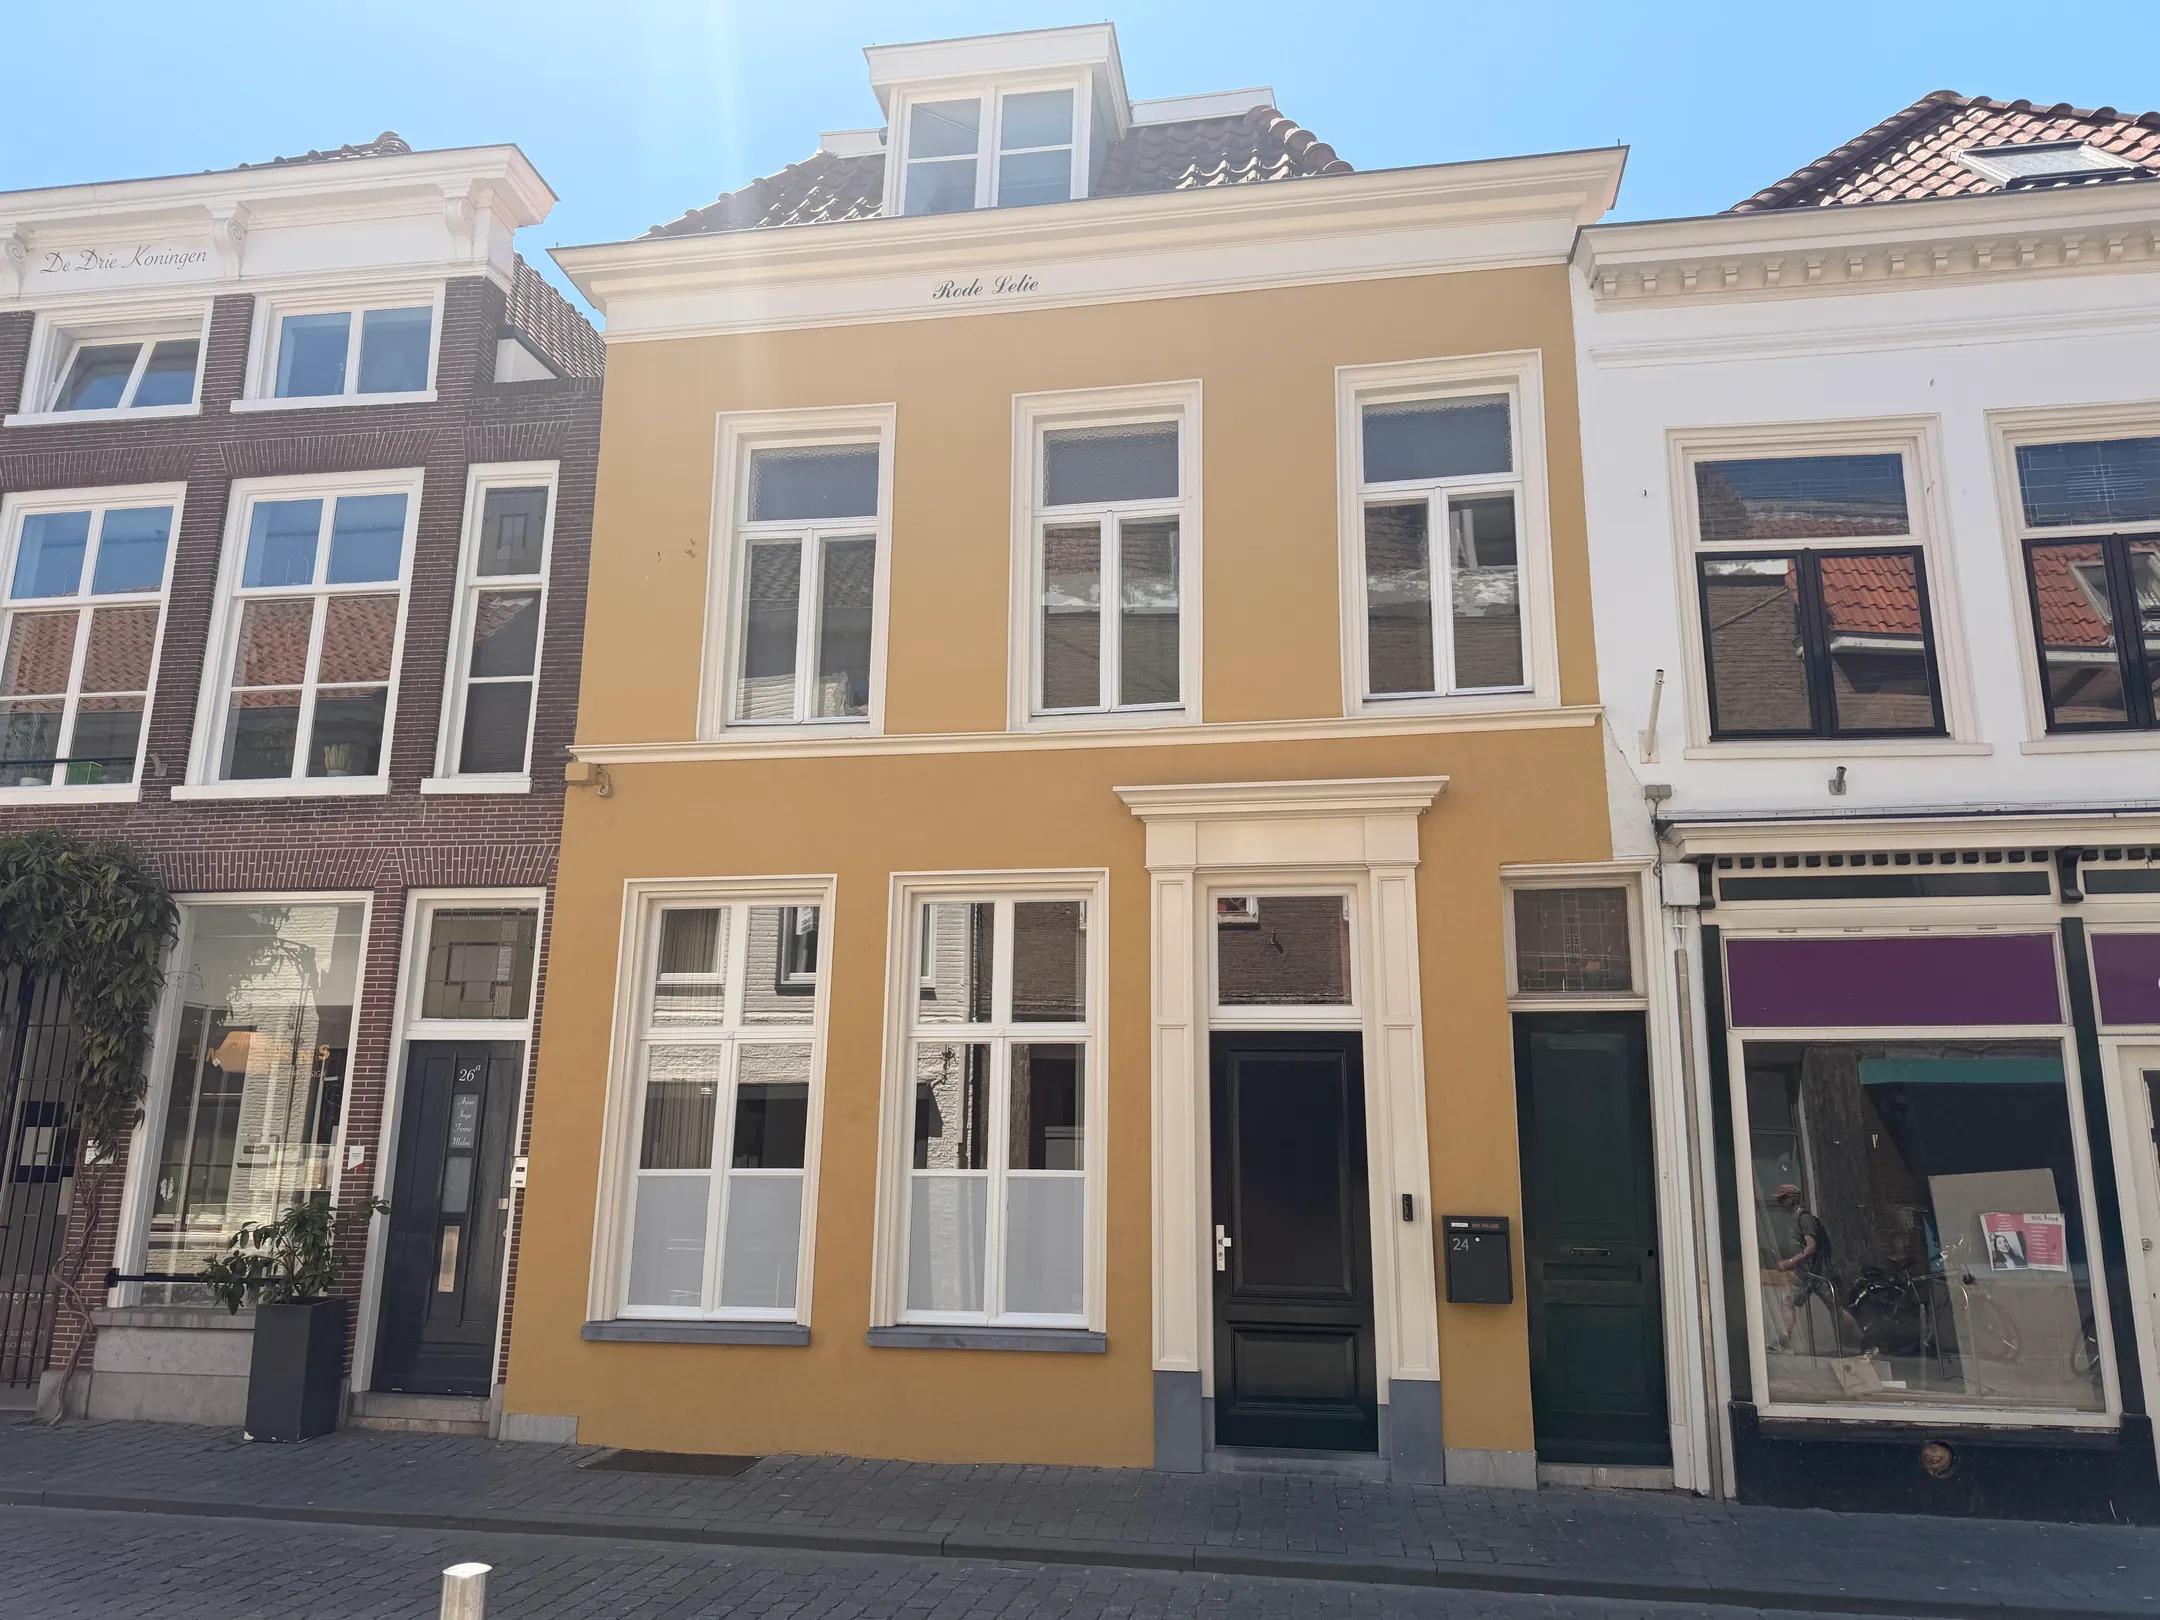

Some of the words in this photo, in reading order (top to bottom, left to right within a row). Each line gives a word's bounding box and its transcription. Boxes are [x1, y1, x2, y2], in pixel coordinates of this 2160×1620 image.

[40, 251, 71, 274] De
[75, 249, 118, 271] Drie
[121, 244, 207, 270] Koningen
[932, 278, 984, 300] Rode
[991, 274, 1039, 295] Lelie
[1452, 1237, 1469, 1250] 24
